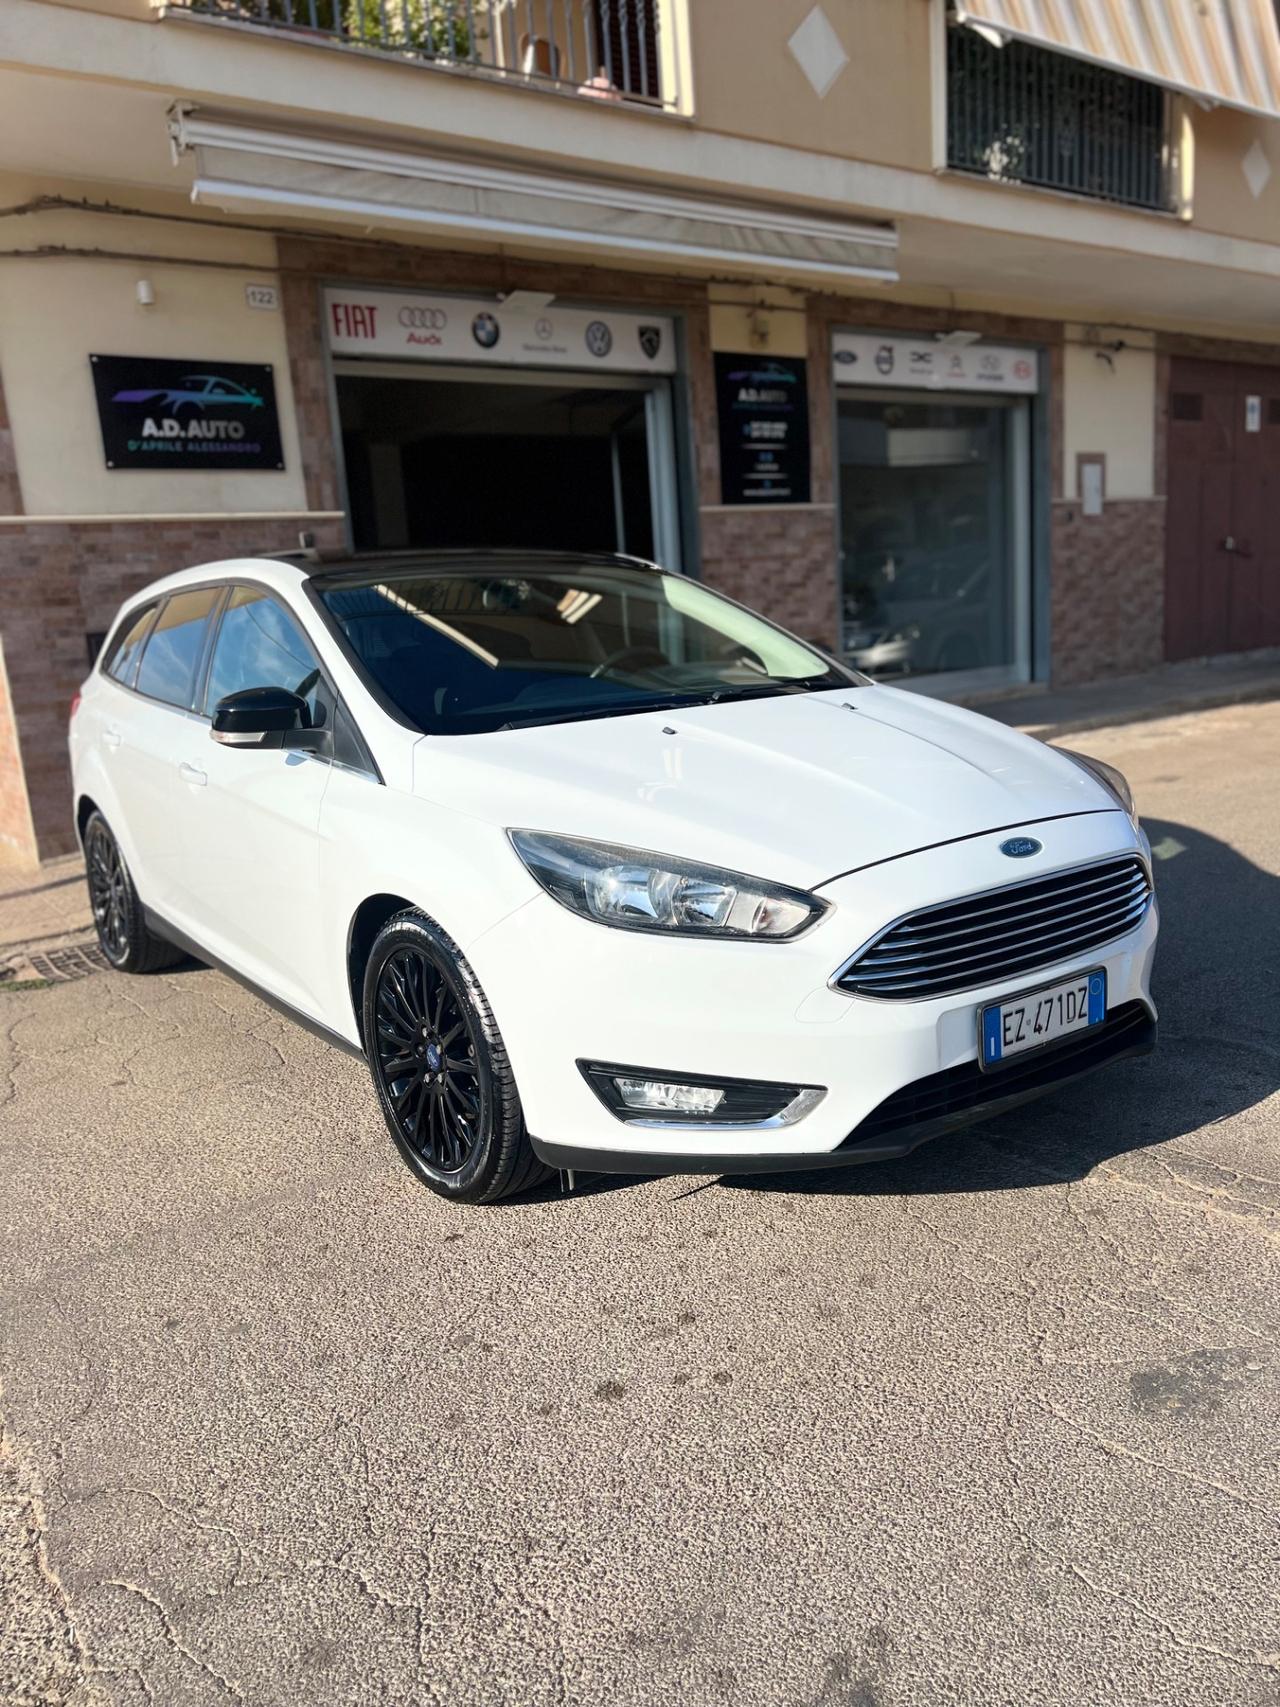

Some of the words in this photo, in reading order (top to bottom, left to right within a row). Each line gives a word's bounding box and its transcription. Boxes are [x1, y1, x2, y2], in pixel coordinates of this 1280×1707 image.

[250, 290, 273, 304] 122
[331, 303, 377, 339] FIAT
[405, 333, 442, 345] Audi
